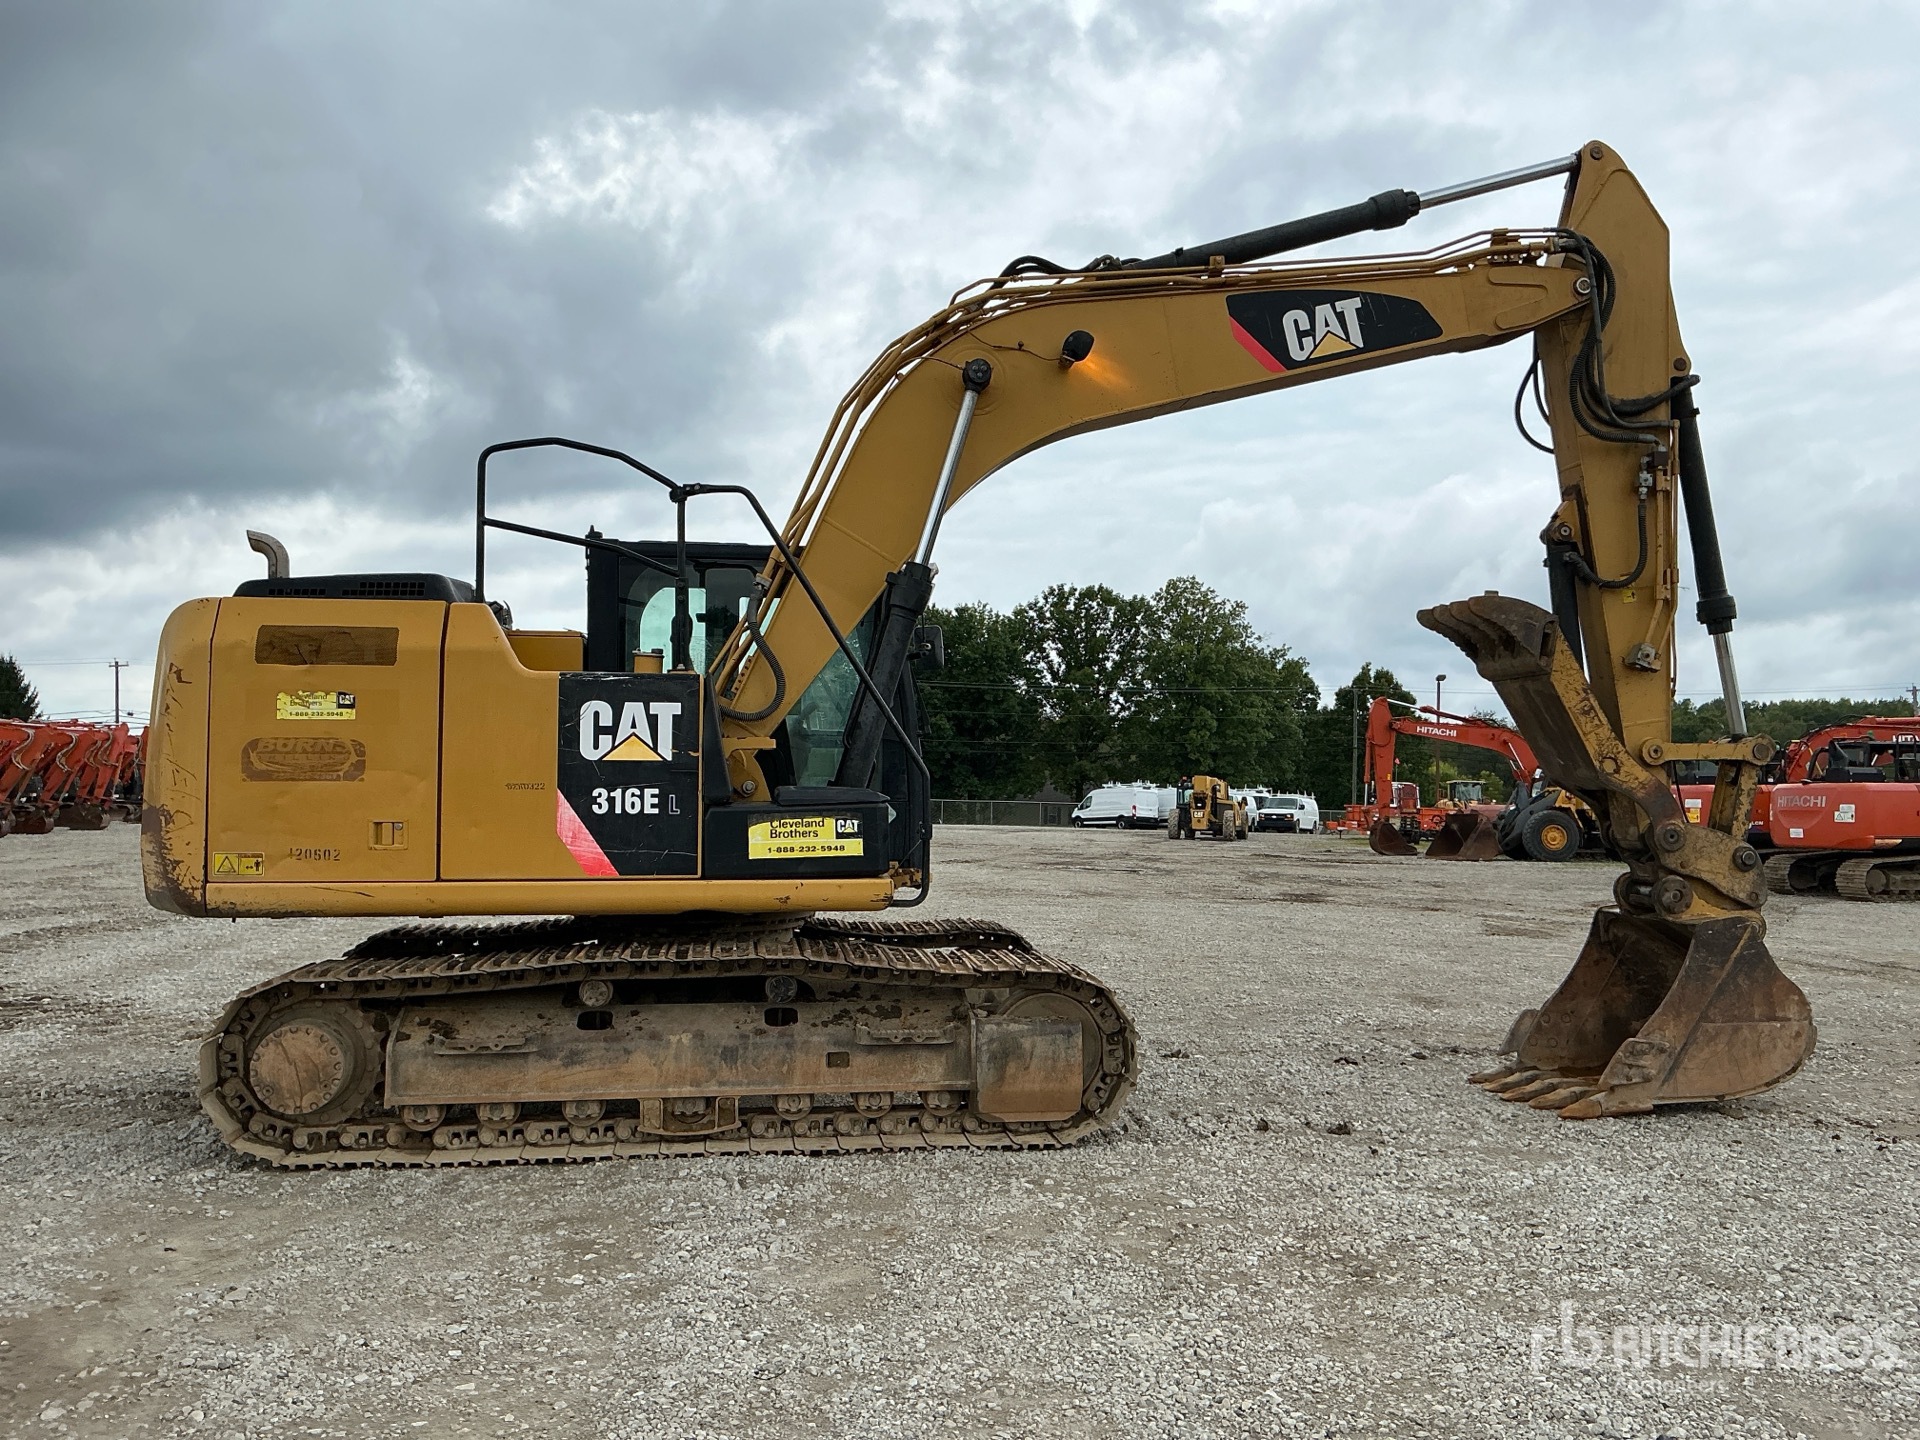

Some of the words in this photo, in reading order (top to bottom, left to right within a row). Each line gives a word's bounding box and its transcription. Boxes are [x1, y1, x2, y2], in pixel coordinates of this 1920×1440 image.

[1283, 297, 1364, 361] CAT
[339, 695, 355, 705] CAT
[580, 700, 681, 761] CAT
[1417, 726, 1457, 737] HITACHI
[591, 787, 660, 814] 316E
[668, 794, 680, 814] L
[1777, 795, 1827, 808] HITACHI
[1193, 810, 1204, 818] CAT
[769, 817, 825, 829] Cleveland
[836, 819, 860, 833] CAT
[769, 828, 819, 839] Brothers
[767, 845, 845, 853] 1-888-232-5948
